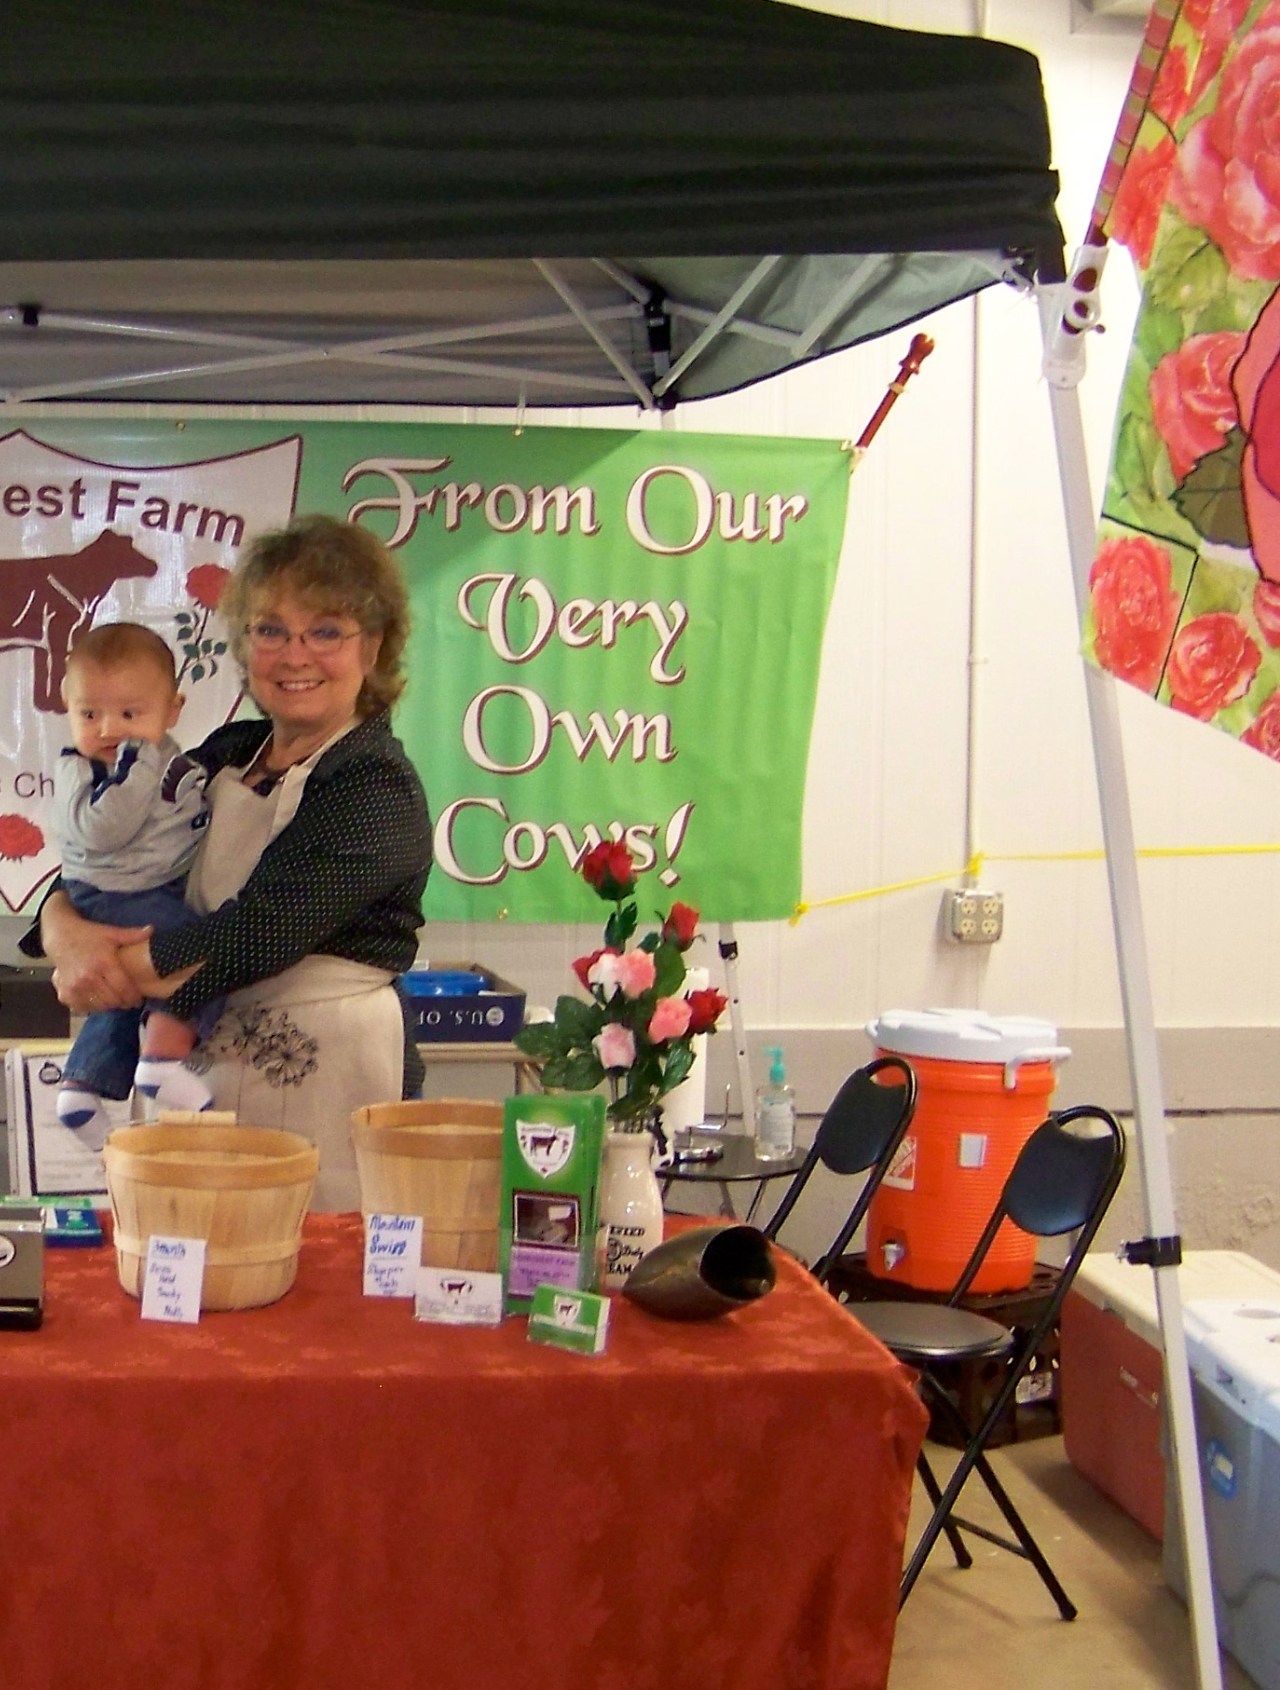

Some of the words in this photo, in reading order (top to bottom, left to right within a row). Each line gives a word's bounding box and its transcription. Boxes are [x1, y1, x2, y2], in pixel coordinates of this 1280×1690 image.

[105, 480, 246, 548] Farm
[341, 456, 601, 548] From
[626, 464, 809, 556] Our
[457, 572, 689, 686] Very
[462, 685, 678, 776] Own
[13, 773, 54, 799] Ch
[433, 798, 697, 888] Cows!
